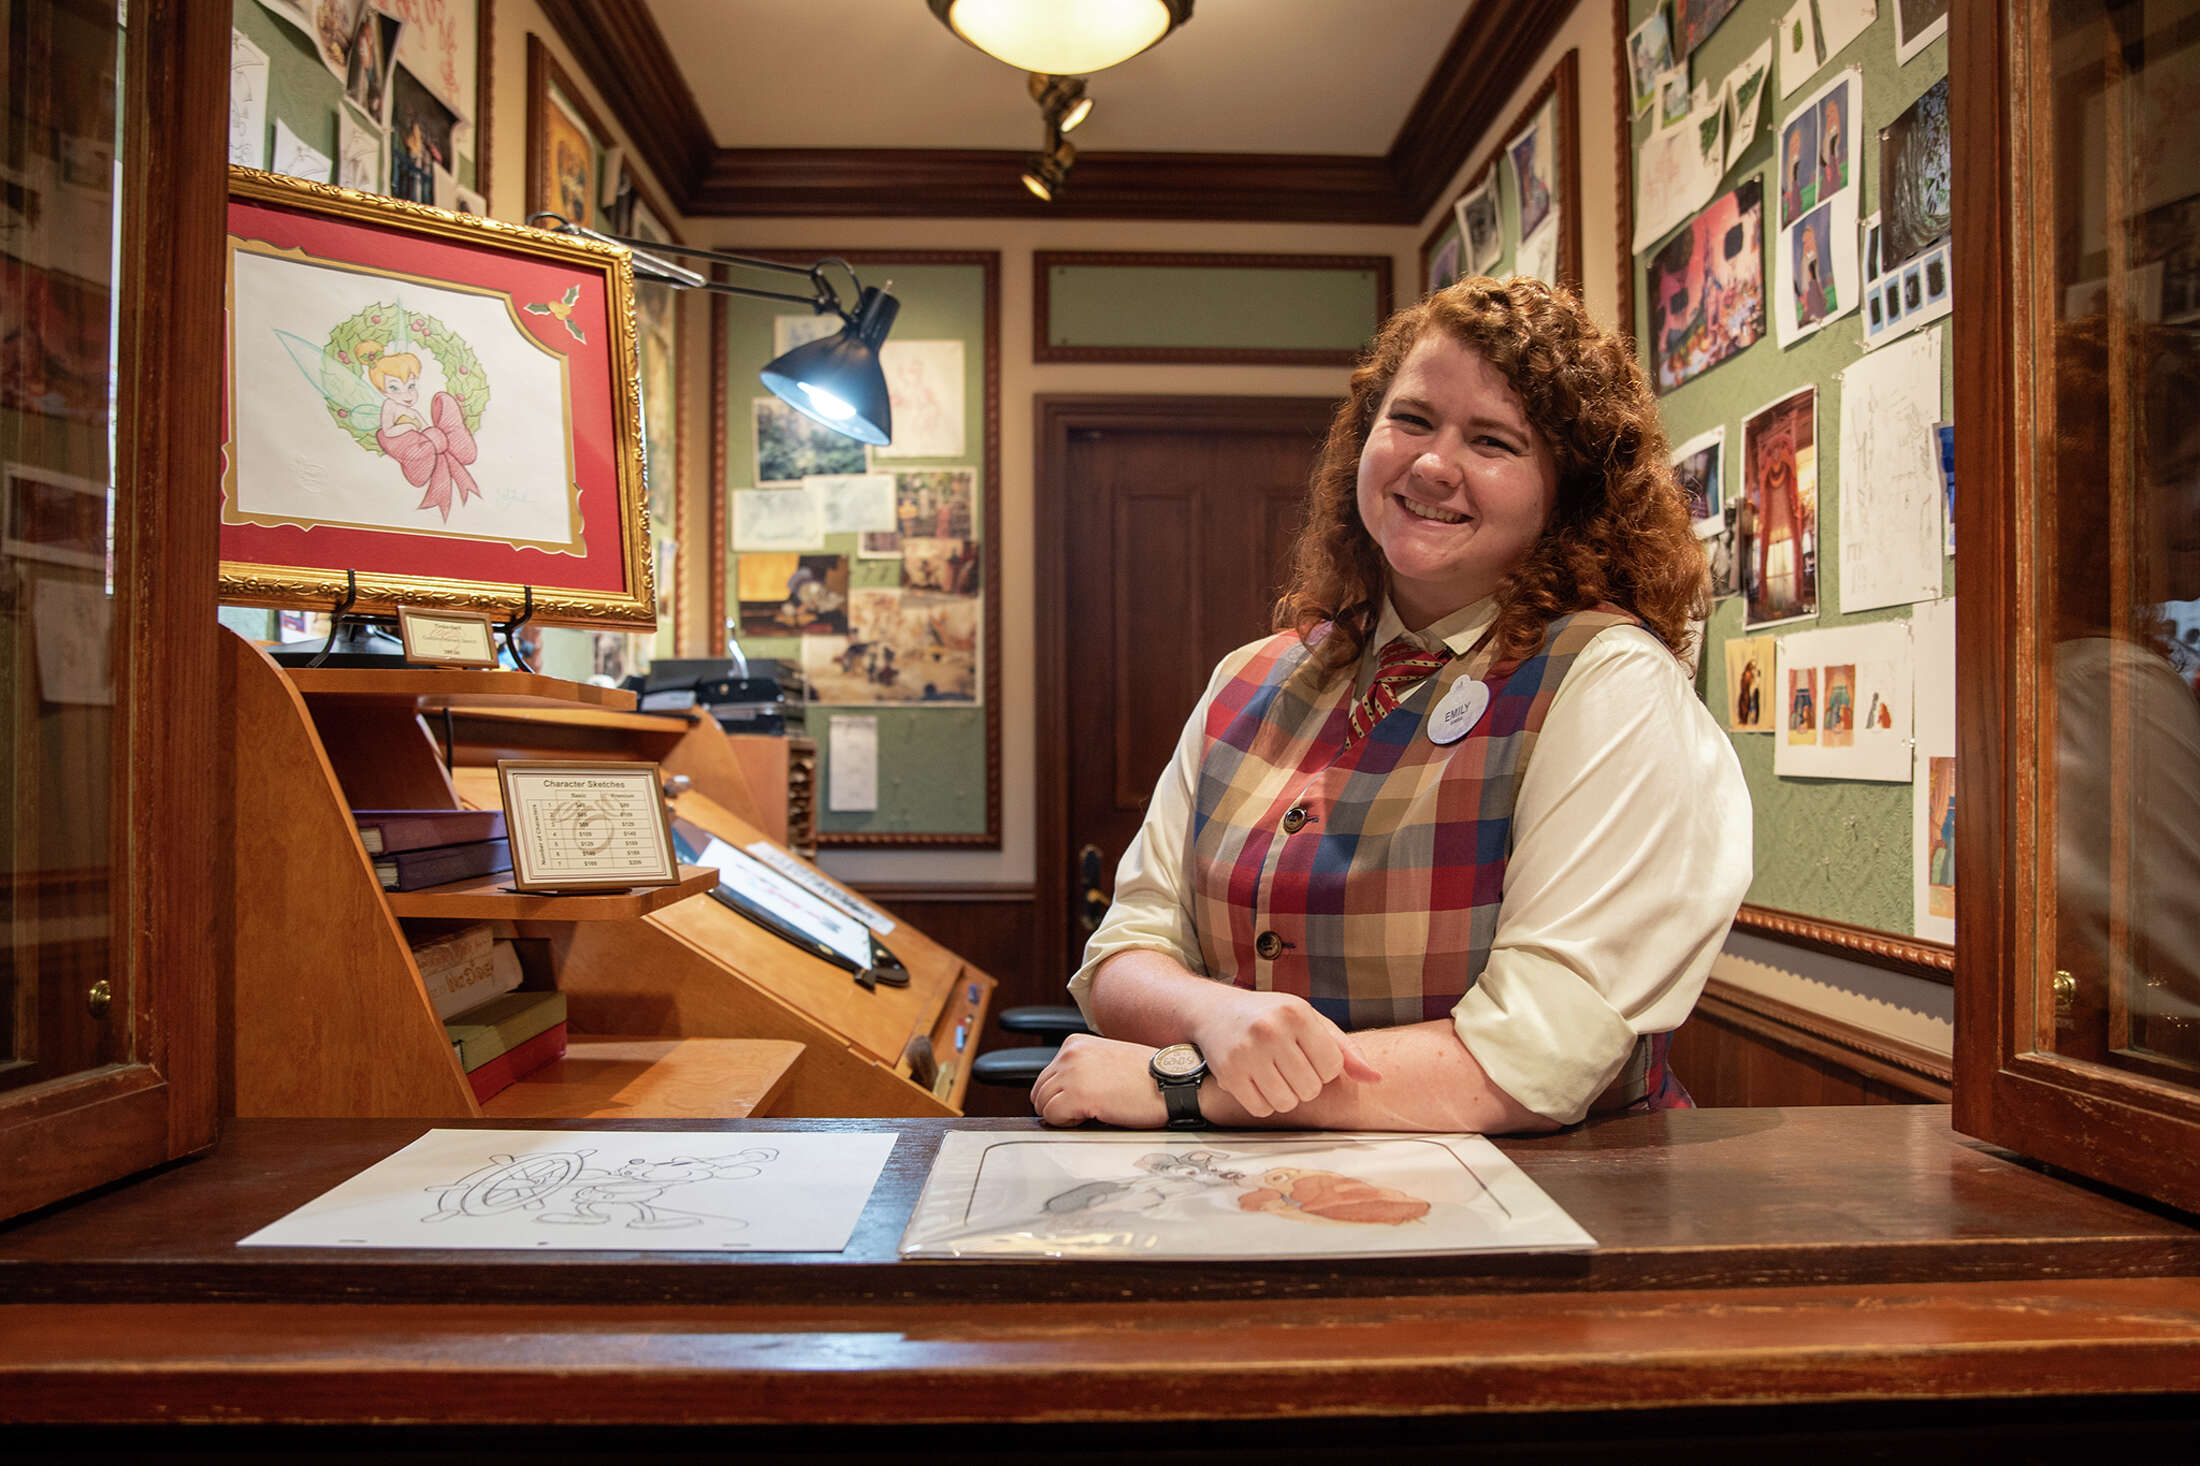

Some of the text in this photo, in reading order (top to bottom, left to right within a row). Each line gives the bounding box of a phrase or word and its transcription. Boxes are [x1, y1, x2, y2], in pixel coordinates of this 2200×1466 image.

[1445, 701, 1471, 722] EMILY
[543, 779, 625, 789] Character Sketches
